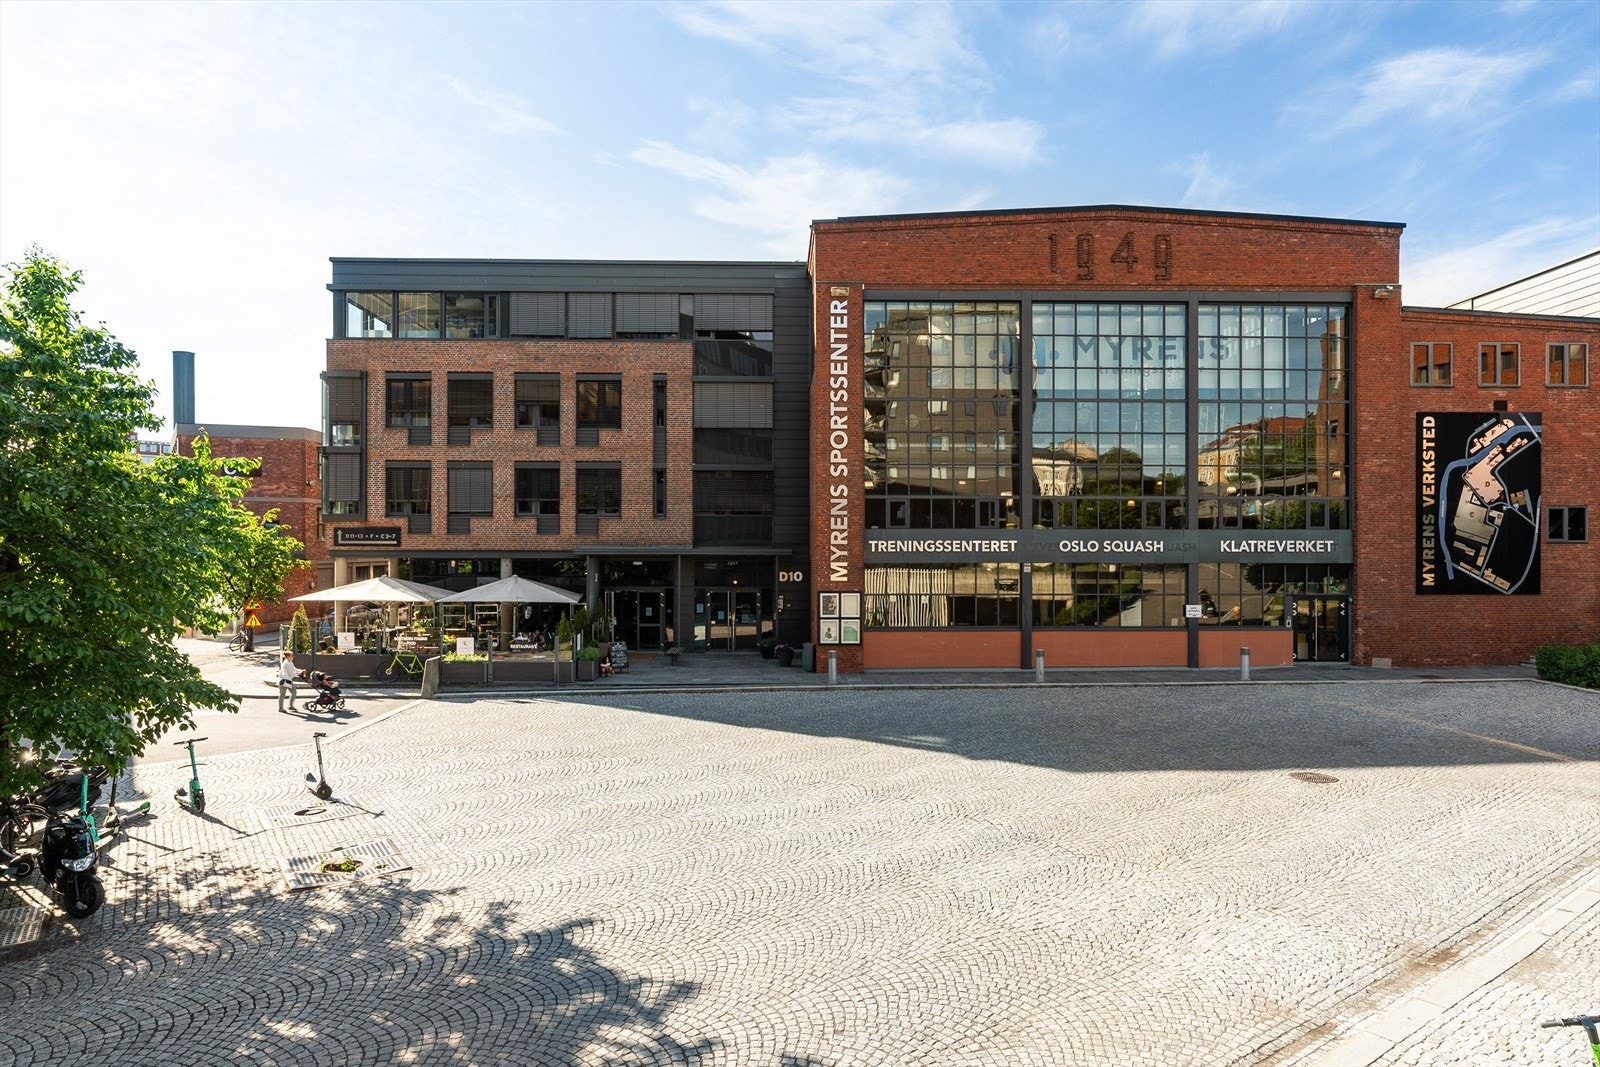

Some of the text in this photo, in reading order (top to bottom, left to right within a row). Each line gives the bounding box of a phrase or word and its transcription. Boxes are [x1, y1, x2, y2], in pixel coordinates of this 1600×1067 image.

[1048, 232, 1172, 280] 1949
[1073, 335, 1231, 361] MYRES
[830, 299, 848, 477] SPORTSSENTER
[1422, 415, 1436, 586] MYRENS VERKSTED
[830, 484, 848, 582] MYRENS
[868, 540, 1018, 552] TRENINGSSENTERET
[1059, 540, 1099, 552] OSLO
[1103, 540, 1164, 553] SQUASH
[1220, 540, 1334, 553] KLATREVERKET
[779, 571, 803, 582] D10
